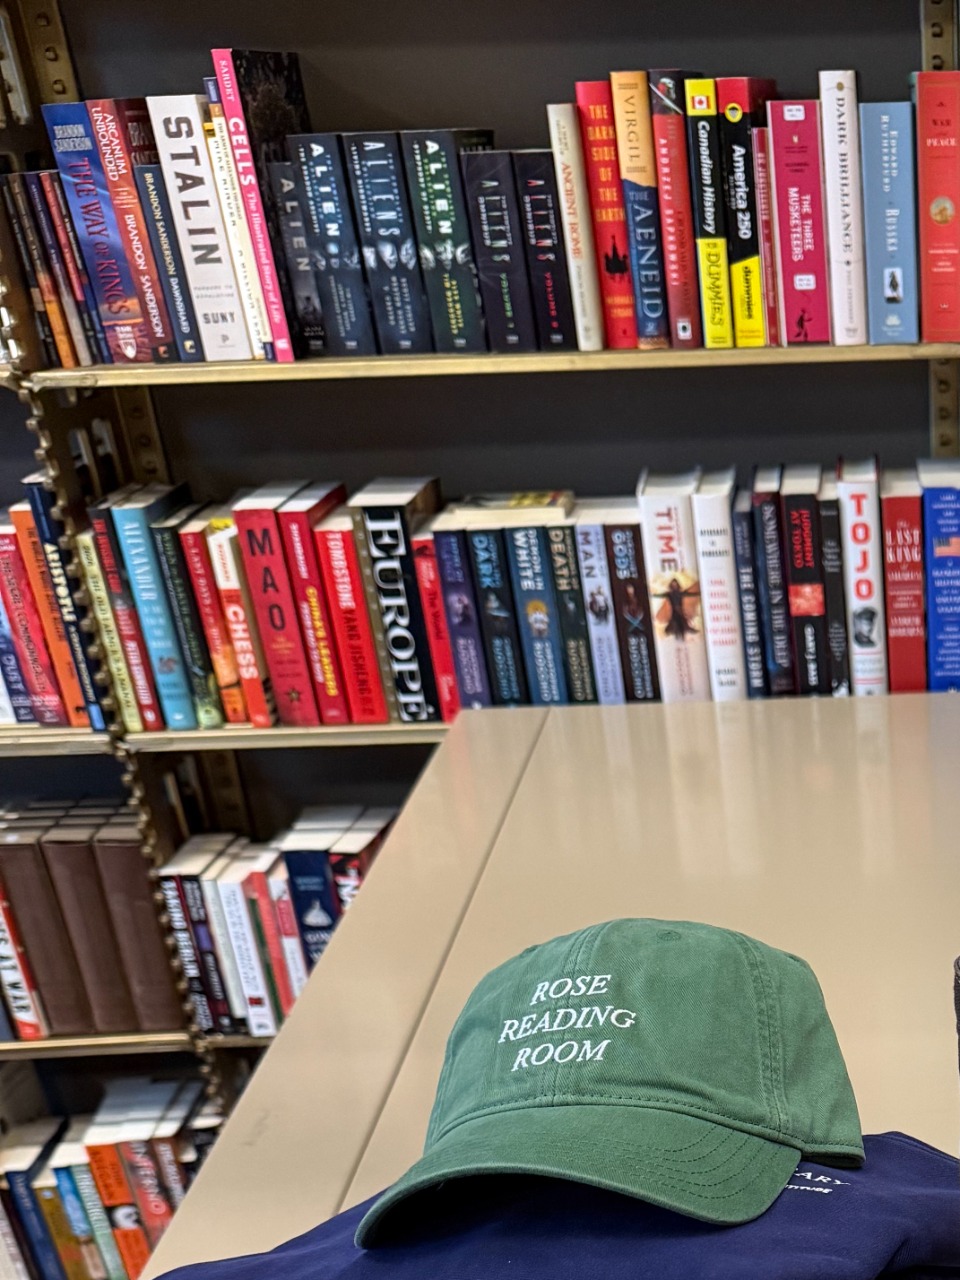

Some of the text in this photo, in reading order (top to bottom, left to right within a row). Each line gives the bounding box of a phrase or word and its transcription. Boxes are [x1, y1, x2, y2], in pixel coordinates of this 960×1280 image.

[218, 58, 236, 102] SARDET
[586, 126, 615, 140] DARK
[588, 104, 609, 119] THE
[623, 95, 641, 163] VIRGIL
[91, 106, 120, 182] UNBOUNDED
[103, 111, 129, 176] ARCANUM
[227, 116, 257, 188] CELLS
[591, 146, 616, 161] SIDE
[731, 143, 748, 201] America
[889, 130, 899, 178] EDWARD
[926, 138, 958, 147] PEACE
[162, 114, 224, 267] STALIN
[246, 191, 258, 212] The
[309, 141, 341, 237] ALIEN
[362, 141, 401, 237] ALIENS
[424, 140, 454, 234] ALIEN
[598, 187, 618, 202] THE
[599, 167, 612, 182] OF
[696, 119, 717, 236] Canadian History
[835, 97, 854, 255] DARK BRILLIANCE
[67, 156, 131, 317] THE WAY OF KINGS
[250, 213, 269, 263] Illustrated
[279, 177, 311, 272] ALIEN
[560, 161, 578, 213] ANCIENT
[569, 217, 584, 260] ROME
[658, 138, 681, 286] ANDRZEJ SAPKOWSKI
[737, 203, 752, 241] 250
[787, 186, 803, 263] MUSKETEERS
[801, 193, 814, 252] THE THREE
[885, 207, 900, 252] RUSSKA
[124, 213, 165, 339] BRANDON SANDERSON
[144, 171, 191, 334] BRANDON SANDERSON DAWNSHARD
[262, 264, 275, 291] Story
[633, 203, 664, 320] AENEID
[201, 312, 237, 326] SUNY
[705, 251, 725, 328] DUMMIES
[740, 264, 755, 321] dummies
[122, 520, 158, 602] ALEXANDER
[472, 534, 494, 590] DARK
[512, 531, 537, 593] WHITE
[528, 529, 542, 573] DEMON
[550, 529, 572, 593] DEATH
[578, 530, 597, 580] MAN
[610, 530, 632, 581] GODS
[654, 506, 680, 575] TIME
[790, 510, 804, 569] AT TOKYO
[800, 509, 815, 569] JUDGMENT
[850, 493, 874, 600] TOJO
[885, 529, 920, 545] LAST
[885, 545, 921, 562] KING
[43, 542, 78, 623] ARISTOTLE
[246, 528, 287, 632] MAO
[325, 532, 357, 611] TOMBSTONE
[342, 610, 361, 641] YANG
[427, 587, 438, 606] The
[738, 565, 756, 591] THE
[761, 504, 791, 668] SOMEWHERE IN THE DEEP
[225, 603, 260, 681] CHESS
[305, 585, 340, 698] CHINA'S LEADERS
[363, 508, 429, 722] EUROPE
[742, 596, 760, 643] COMING
[747, 644, 765, 689] STORM
[7, 981, 32, 1013] WAR
[530, 974, 612, 1006] ROSE
[497, 1004, 637, 1044] READING
[510, 1039, 611, 1073] ROOM
